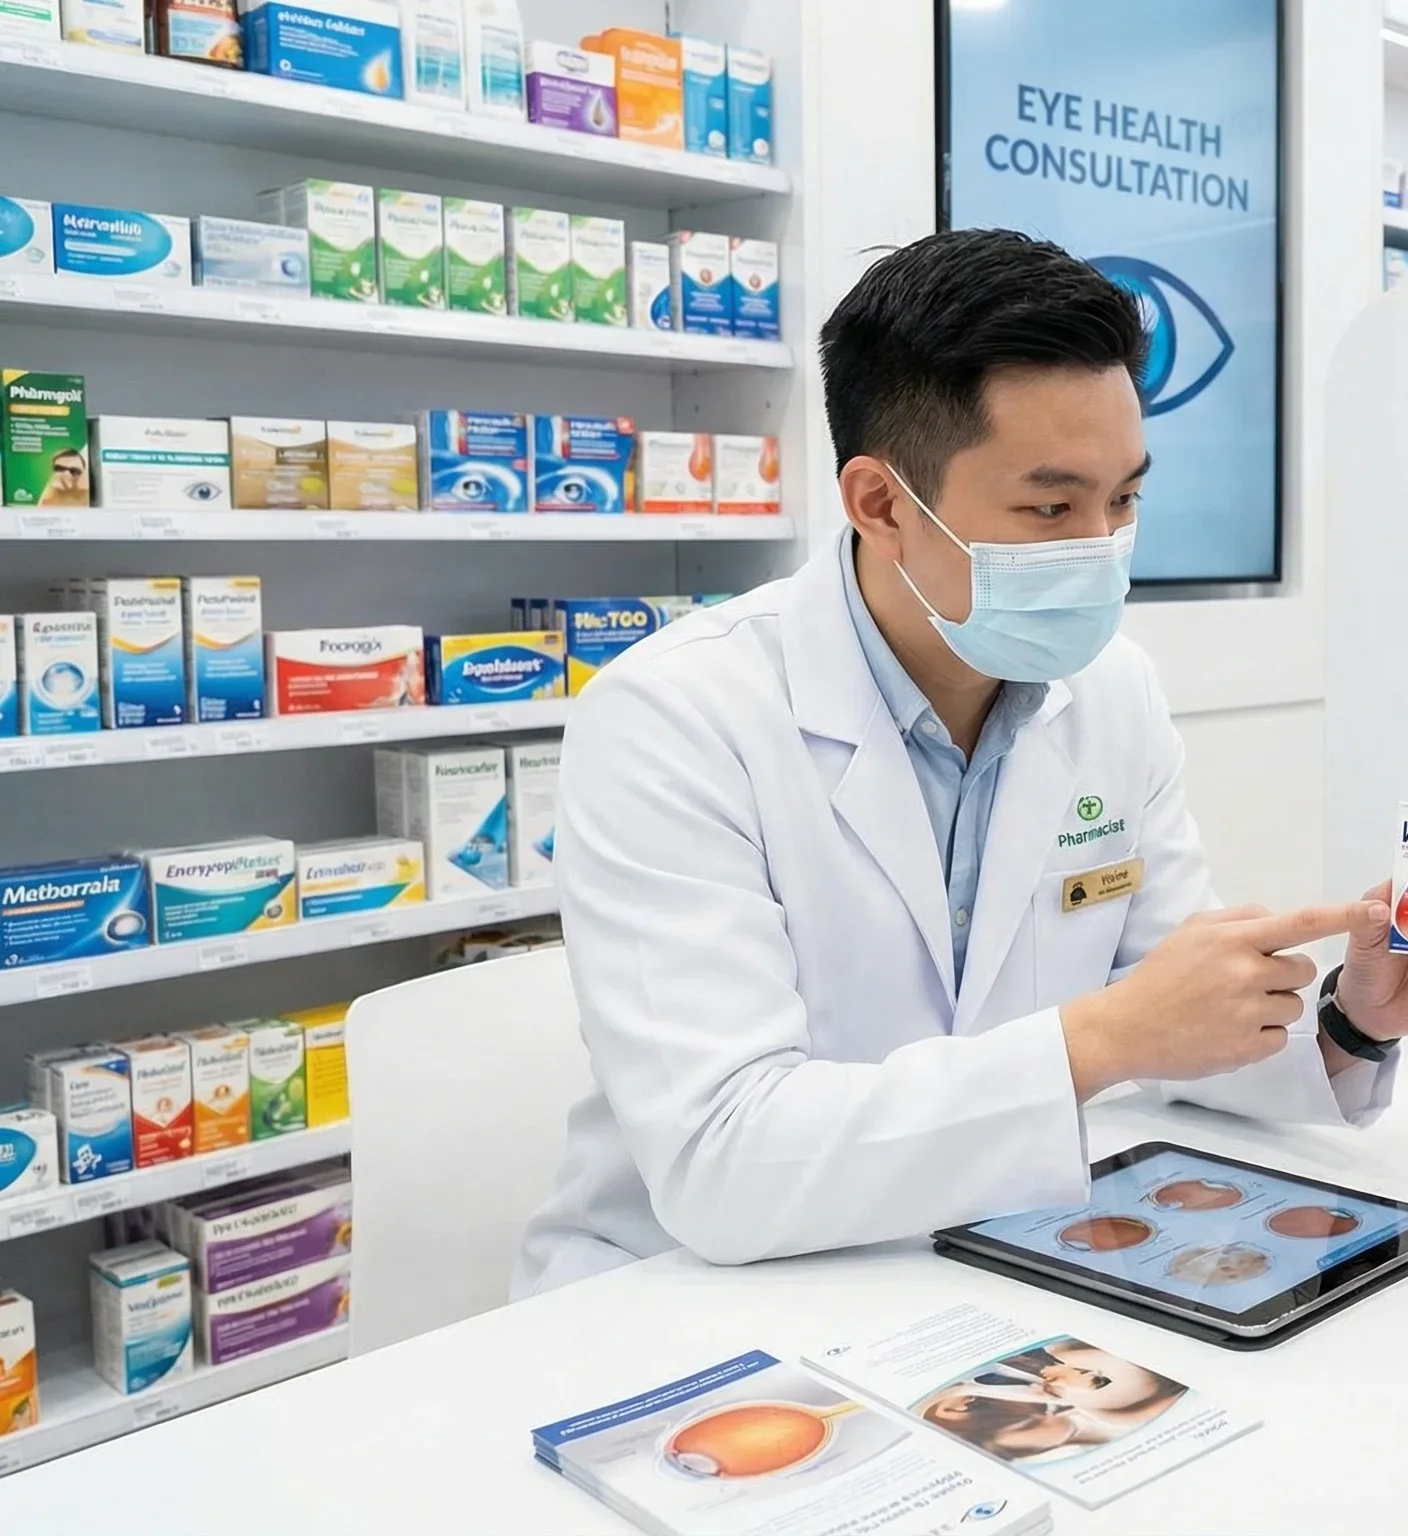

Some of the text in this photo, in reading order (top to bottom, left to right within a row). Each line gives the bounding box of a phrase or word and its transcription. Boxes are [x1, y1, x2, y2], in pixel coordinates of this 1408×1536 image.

[1017, 83, 1222, 158] EYE HEALTH
[985, 134, 1250, 212] CONSULTATION
